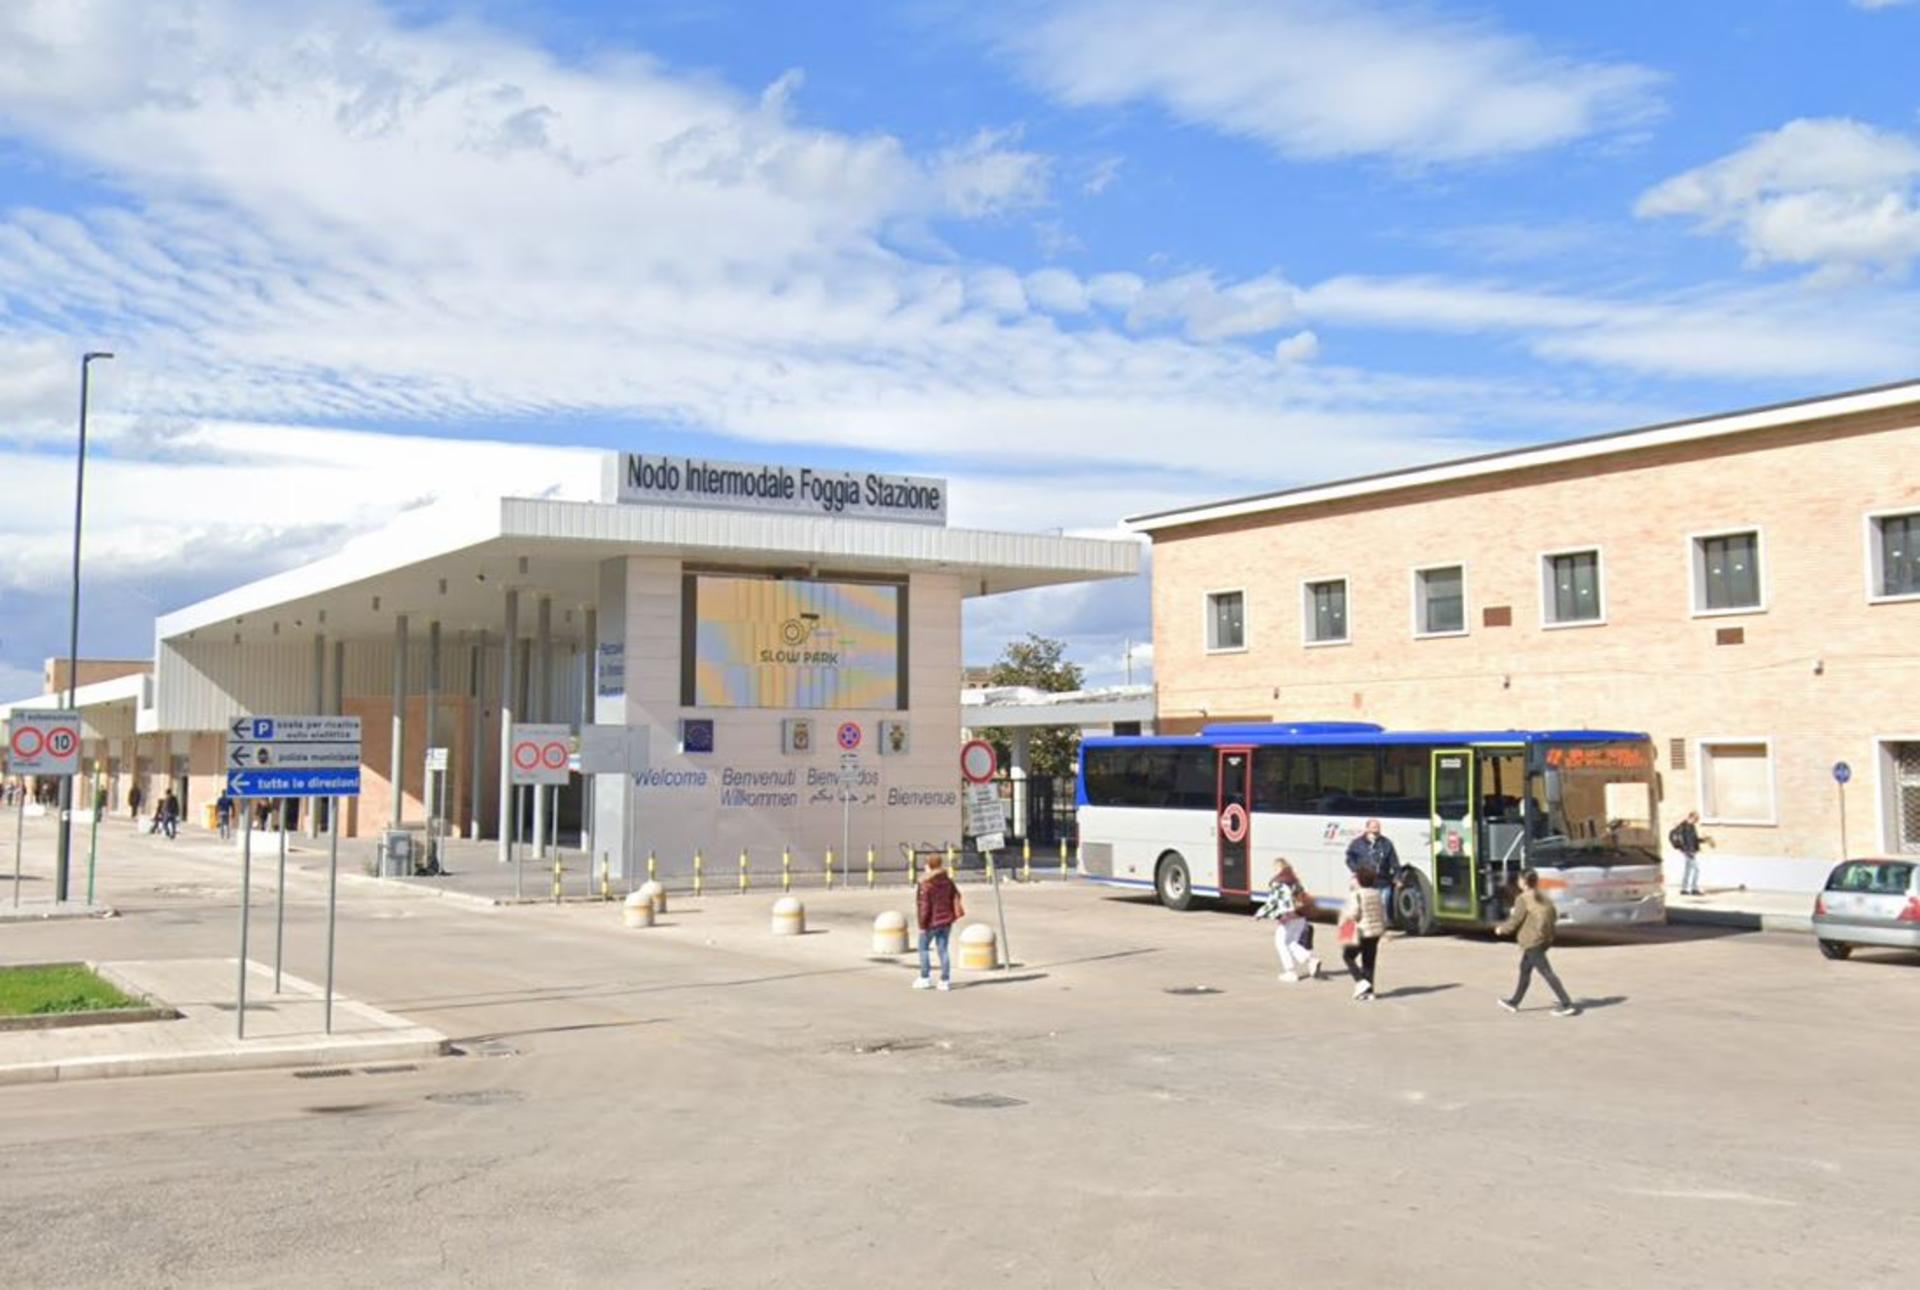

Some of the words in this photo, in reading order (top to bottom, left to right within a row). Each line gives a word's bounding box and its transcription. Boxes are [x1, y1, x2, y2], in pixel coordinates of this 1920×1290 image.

[628, 454, 679, 490] Nodo
[686, 459, 794, 499] Intermodale
[801, 469, 860, 512] Foggia
[866, 475, 940, 510] Stazione
[760, 650, 801, 663] SLOW
[803, 651, 839, 665] PARK
[258, 722, 270, 736] P
[55, 735, 70, 750] 10
[258, 778, 289, 789] tutte
[292, 778, 305, 789] le
[307, 777, 359, 789] direzioni
[635, 768, 707, 786] Welcome
[722, 768, 797, 786] Benvenuti
[721, 789, 798, 807] Willkommen
[887, 787, 956, 806] Bienvenue
